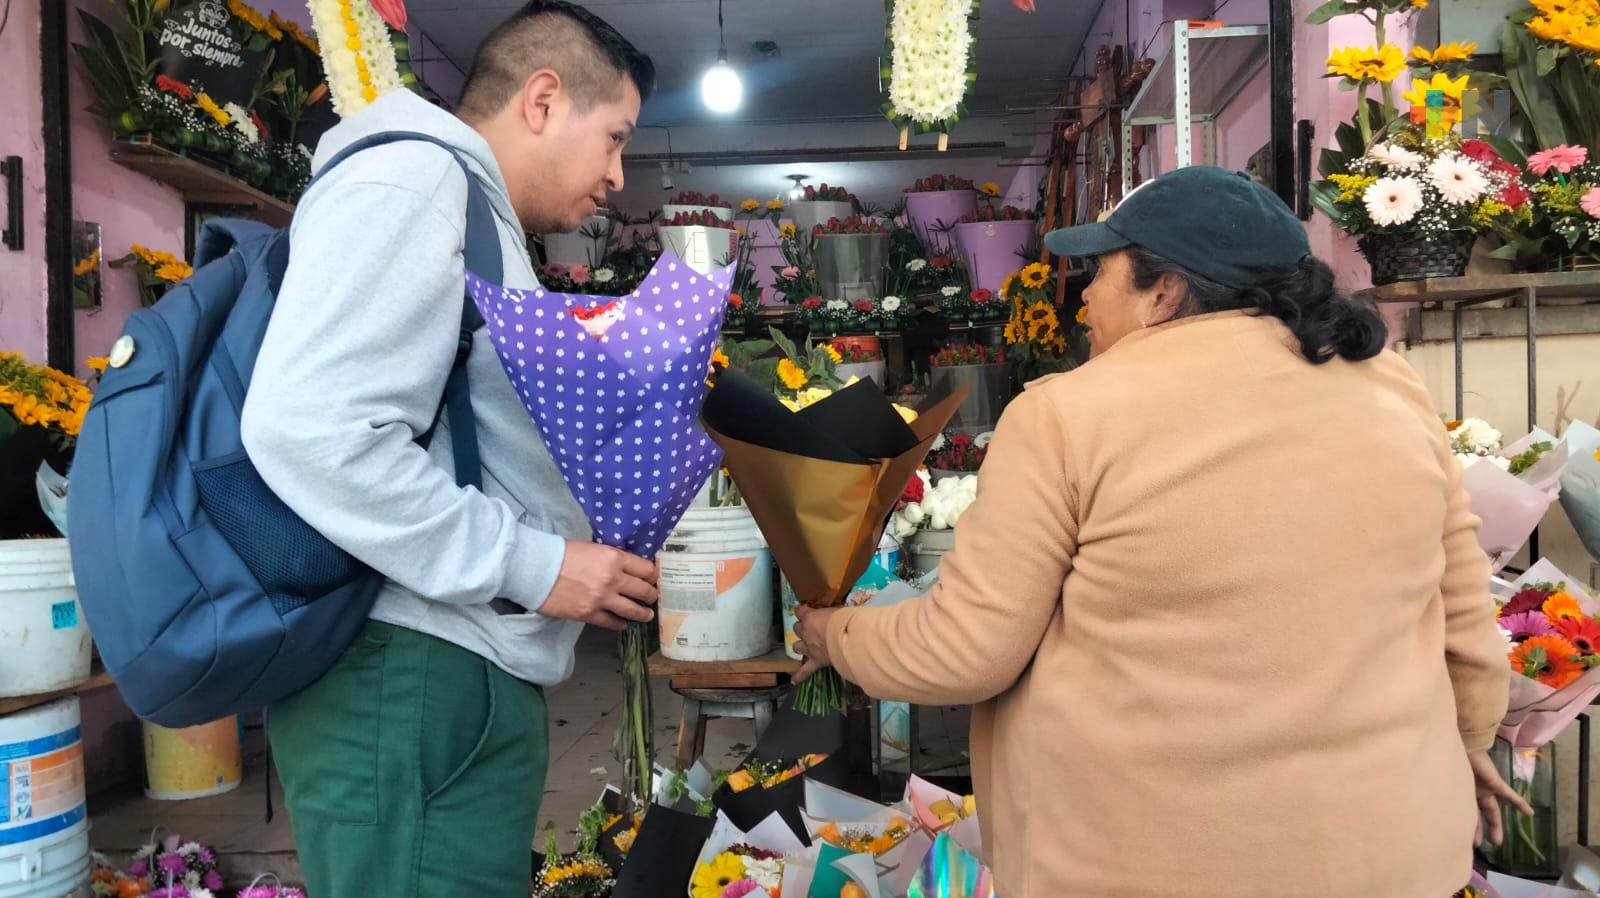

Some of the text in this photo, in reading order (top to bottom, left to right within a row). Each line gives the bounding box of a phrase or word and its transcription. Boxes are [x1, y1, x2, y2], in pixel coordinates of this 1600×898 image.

[160, 28, 241, 68] por siempre
[182, 17, 232, 48] Juntos
